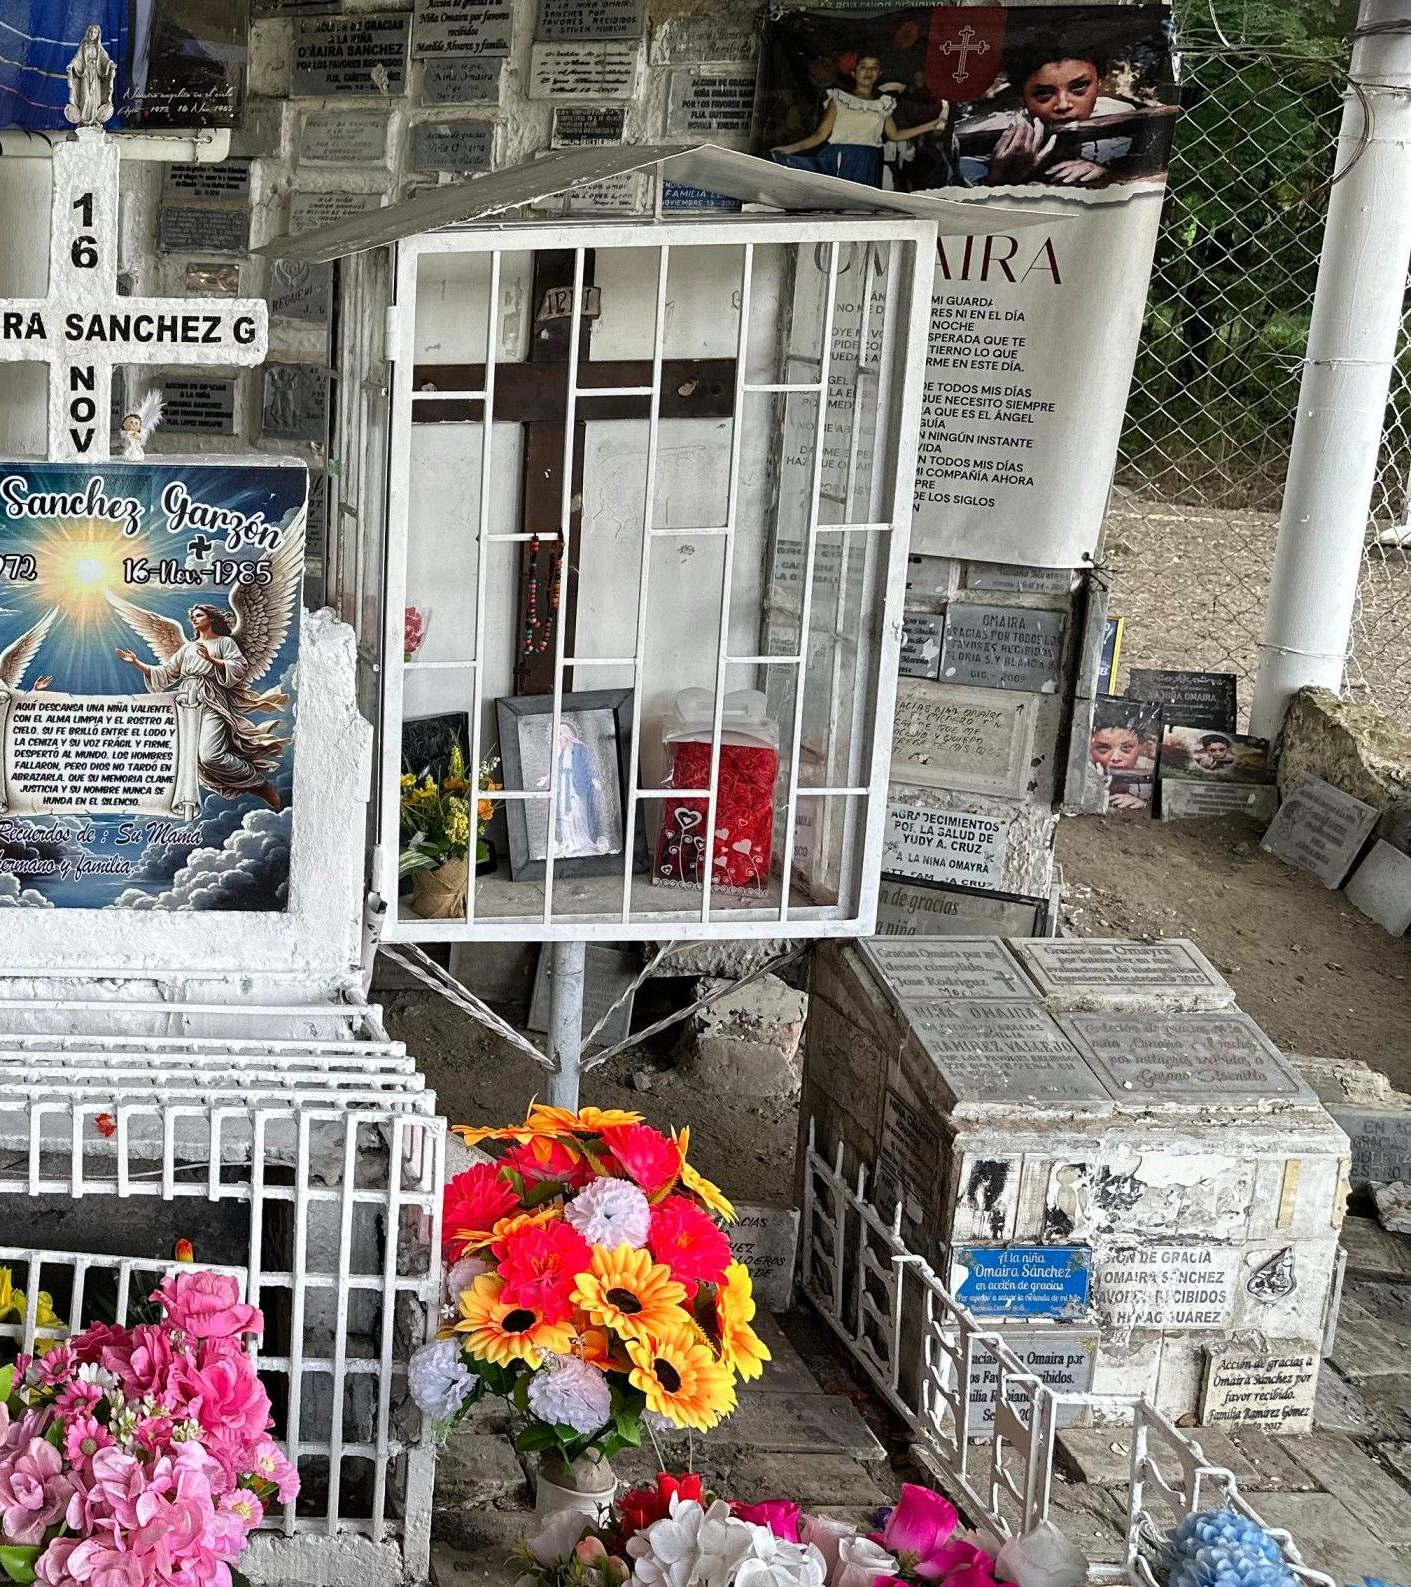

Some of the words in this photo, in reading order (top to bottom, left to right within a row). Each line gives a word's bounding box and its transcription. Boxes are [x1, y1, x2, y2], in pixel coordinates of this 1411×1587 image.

[947, 296, 994, 307] GUARDA
[956, 309, 967, 318] NI
[970, 310, 985, 319] EN
[989, 311, 1002, 320] EL
[1005, 310, 1025, 321] DÍA
[65, 313, 222, 343] SANCHEZ
[233, 317, 256, 344] G
[932, 321, 975, 331] NOCHE
[984, 336, 1008, 346] QUE
[1012, 337, 1026, 347] TE
[930, 345, 972, 356] TIERNO
[974, 348, 990, 357] LO
[993, 349, 1017, 359] QUE
[953, 359, 968, 368] EN
[971, 360, 998, 370] ESTE
[1001, 362, 1024, 372] DÍA.
[938, 383, 978, 394] TODOS
[981, 386, 1001, 395] MIS
[1005, 386, 1032, 397] DÍAS
[945, 396, 1002, 408] NECESITO
[1006, 400, 1055, 412] SIEMPRE
[928, 432, 974, 443] NINGÚN
[977, 435, 1033, 448] INSTANTE
[926, 468, 988, 482] COMPAÑÍA
[991, 474, 1034, 486] AHORA
[0, 475, 144, 538] Sanchez
[162, 481, 283, 551] Garzón
[123, 558, 272, 585] 16-Nov.-1985
[15, 700, 36, 711] AQUÍ
[39, 703, 84, 712] DESCANSA
[86, 704, 104, 712] UNA
[107, 702, 128, 713] NIÑA
[131, 705, 173, 714] VALIENTE,
[13, 715, 31, 723] CON
[33, 715, 43, 723] EL
[73, 716, 103, 724] LIMPIA
[106, 716, 112, 724] Y
[114, 716, 124, 724] EL
[127, 717, 161, 725] ROSTRO
[164, 717, 175, 725] AL
[42, 727, 53, 735] SU
[56, 727, 66, 735] FE
[68, 725, 98, 736] BRILLÓ
[101, 728, 128, 736] ENTRE
[131, 728, 140, 736] EL
[144, 729, 166, 737] LODO
[14, 738, 26, 746] LA
[28, 739, 58, 747] CENIZA
[61, 739, 67, 747] Y
[69, 739, 81, 747] SU
[102, 737, 132, 748] FRÁGIL
[135, 740, 141, 748] Y
[144, 740, 172, 749] FIRME,
[14, 748, 59, 758] DESPERTÓ
[62, 751, 73, 759] AL
[75, 751, 109, 759] MUNDO.
[112, 751, 128, 759] LOS
[131, 752, 173, 760] HOMBRES
[14, 762, 61, 771] FALLARON,
[64, 762, 87, 770] PERO
[90, 763, 110, 771] DIOS
[113, 763, 125, 771] NO
[128, 760, 158, 772] TARDÓ
[160, 764, 171, 772] EN
[11, 773, 65, 781] ABRAZARLA.
[68, 774, 85, 782] QUE
[88, 774, 98, 782] SU
[101, 775, 142, 783] MEMORIA
[145, 775, 175, 784] CLAME
[20, 785, 58, 793] JUSTICIA
[69, 786, 81, 794] SU
[84, 786, 120, 794] NOMBRE
[122, 787, 152, 795] NUNCA
[154, 787, 165, 795] SE
[43, 797, 72, 805] HUNDA
[75, 797, 87, 805] EN
[101, 798, 140, 806] SILENCIO.
[891, 810, 1000, 832] AGRADECIMIENTOS
[76, 823, 96, 844] de
[115, 822, 142, 846] Su
[146, 821, 204, 846] Mamá
[920, 825, 934, 836] LA
[938, 828, 975, 840] SALUD
[979, 833, 994, 843] DE
[903, 834, 932, 848] YUDY
[936, 839, 947, 849] A.
[951, 842, 982, 854] CRUZ
[60, 860, 71, 879] y
[896, 852, 903, 861] A
[908, 853, 920, 863] LA
[949, 860, 989, 874] OMAYRA
[999, 1251, 1007, 1264] A
[1010, 1252, 1020, 1263] la
[1022, 1252, 1044, 1263] niña
[974, 1264, 1020, 1277] Omaira
[1022, 1264, 1071, 1278] Sánchez
[976, 1282, 986, 1290] en
[988, 1280, 1016, 1290] acción
[1018, 1280, 1028, 1289] de
[1030, 1281, 1064, 1295] gracias
